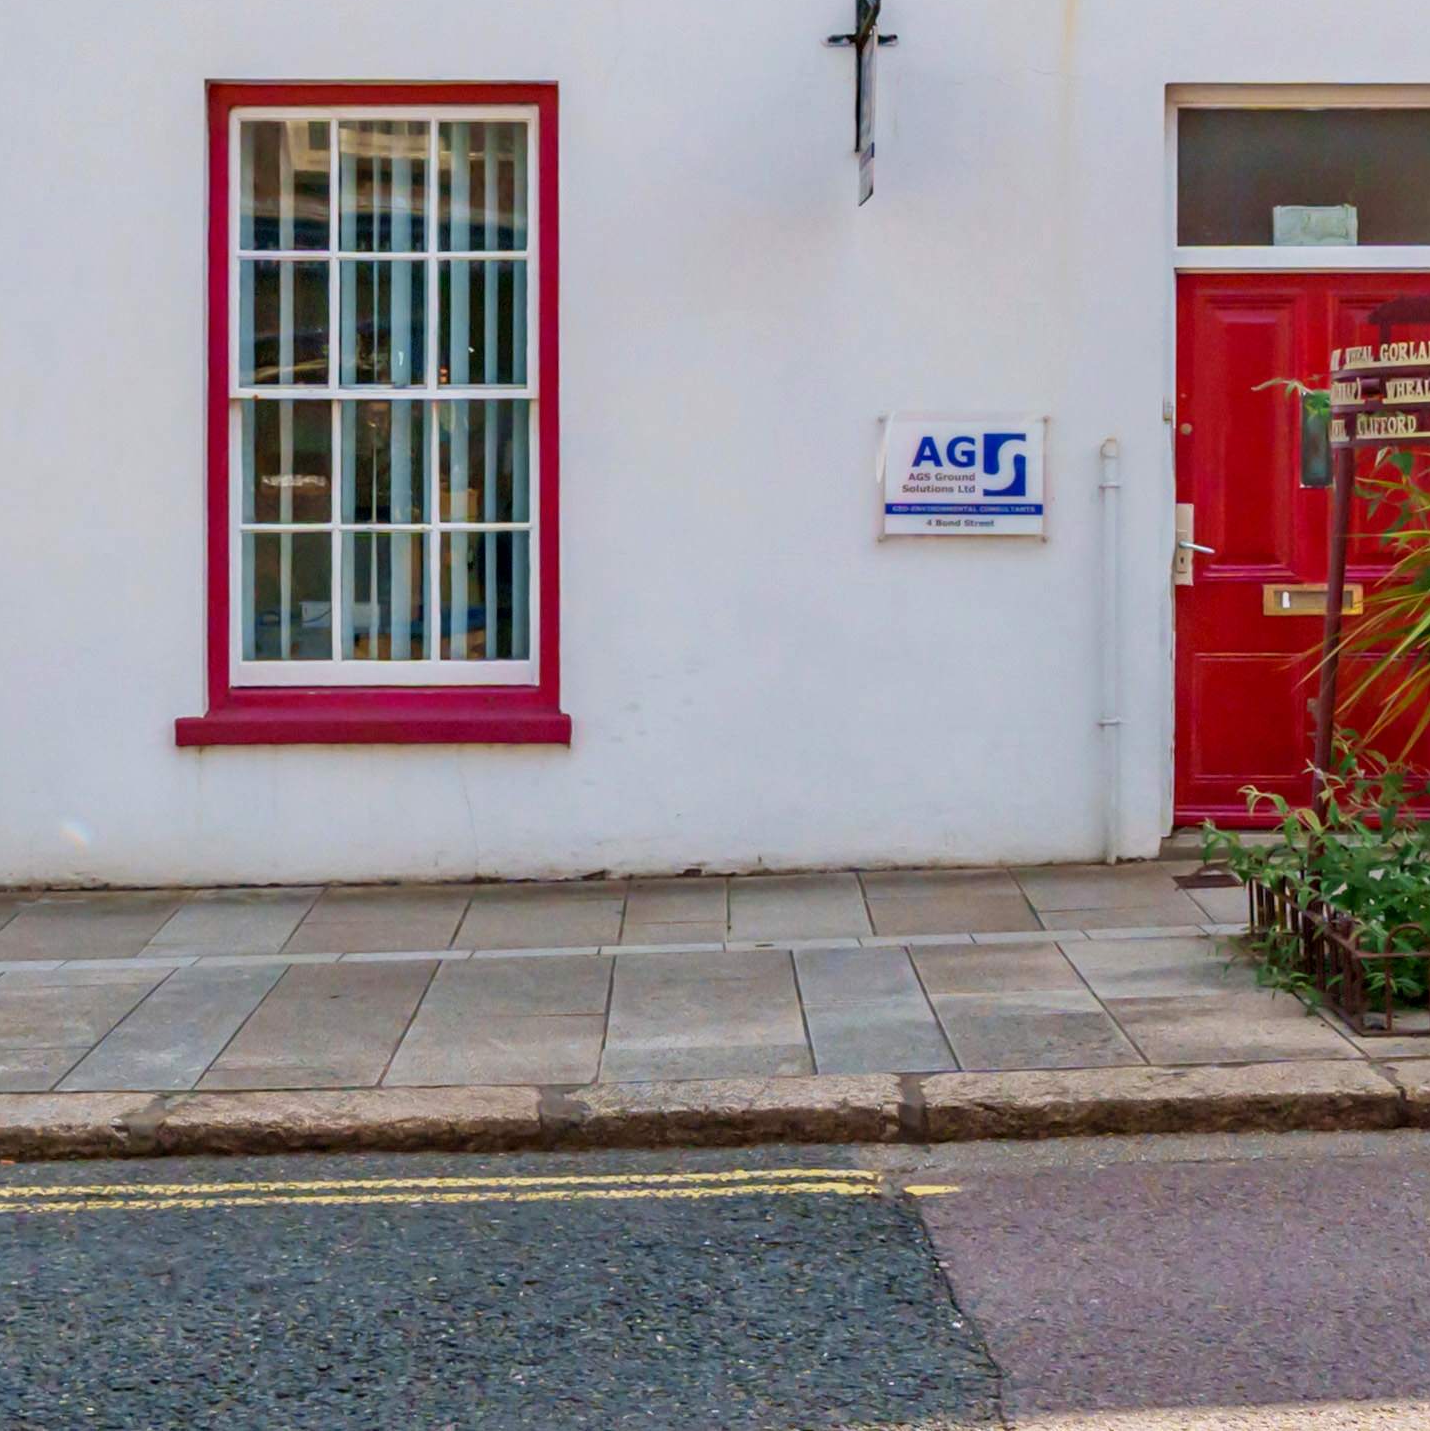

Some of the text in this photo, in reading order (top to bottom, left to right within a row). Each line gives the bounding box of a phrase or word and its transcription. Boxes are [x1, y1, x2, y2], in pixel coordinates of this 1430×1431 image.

[1356, 413, 1417, 435] CLIFFORD
[908, 472, 976, 482] AGS Ground
[902, 484, 976, 494] Solutions Ltd
[935, 519, 961, 527] Bond
[964, 519, 995, 527] Street
